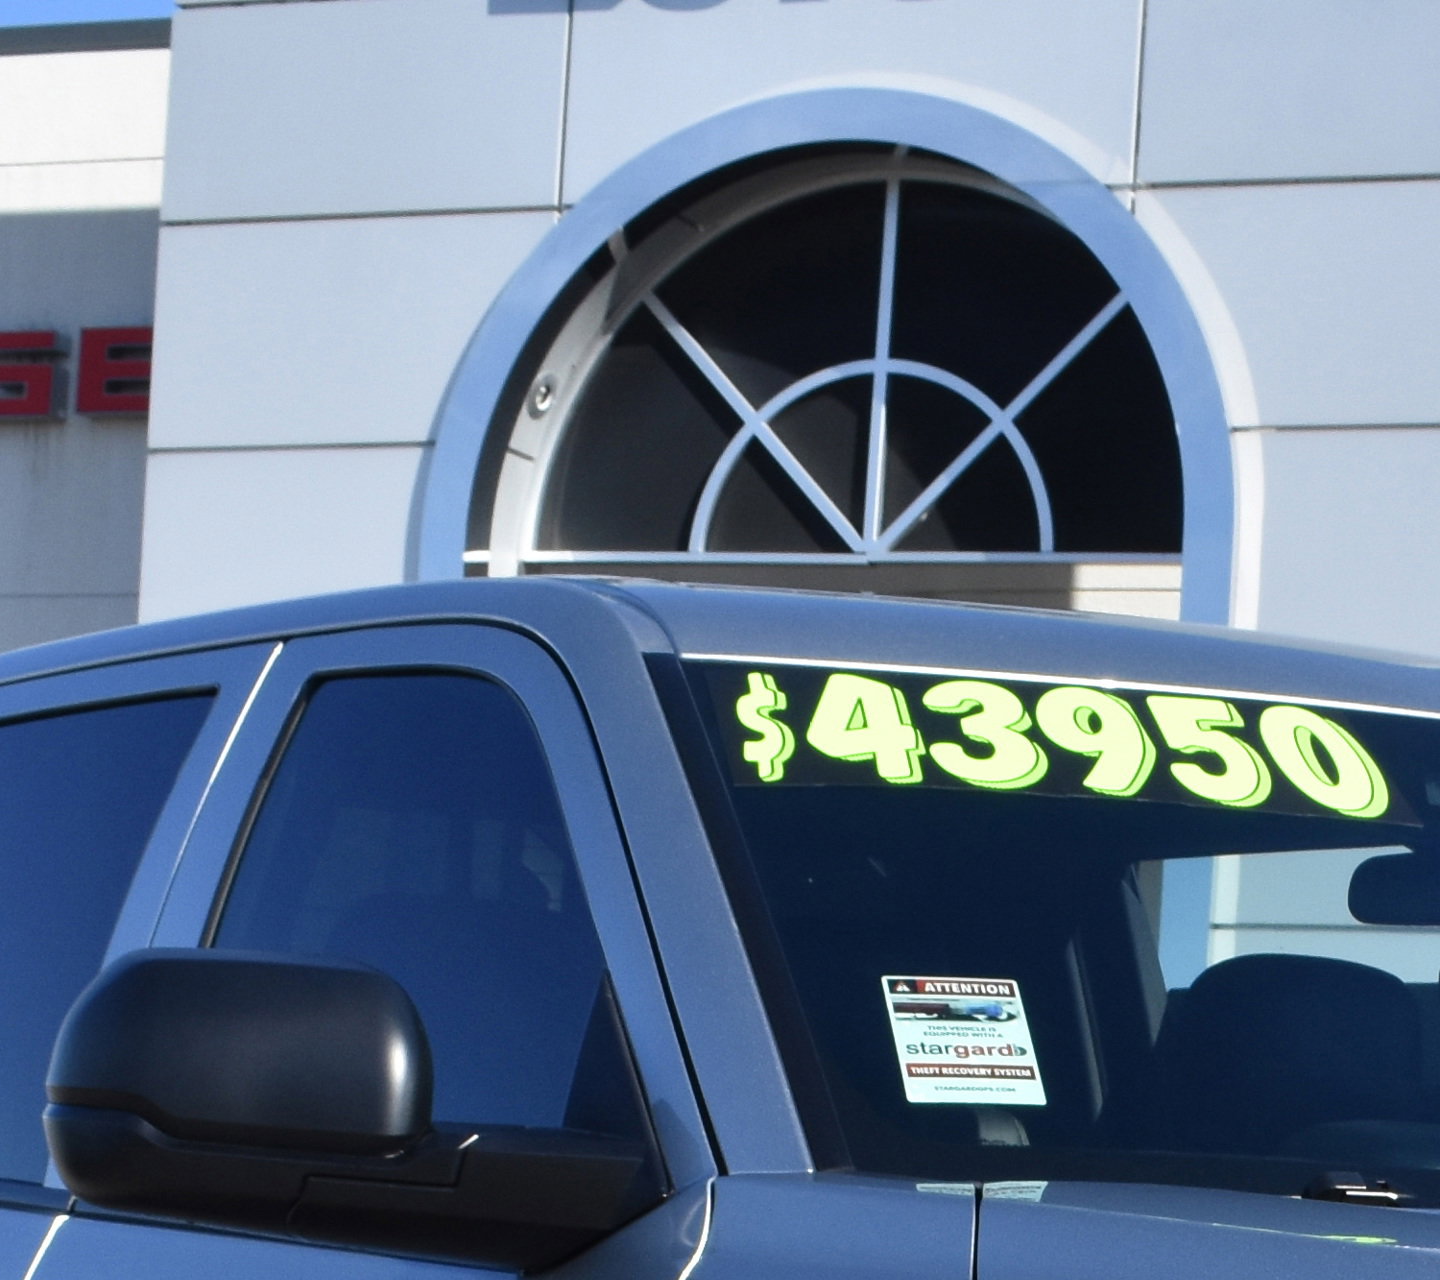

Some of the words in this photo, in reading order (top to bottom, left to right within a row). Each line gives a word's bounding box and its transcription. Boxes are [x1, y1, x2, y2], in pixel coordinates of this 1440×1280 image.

[735, 672, 1390, 819] $43950
[924, 981, 1011, 996] ATTENTION
[905, 1041, 1014, 1059] stargard
[910, 1066, 940, 1075] THEFT
[941, 1067, 992, 1076] RECOVERY
[993, 1068, 1032, 1077] SYSTEM
